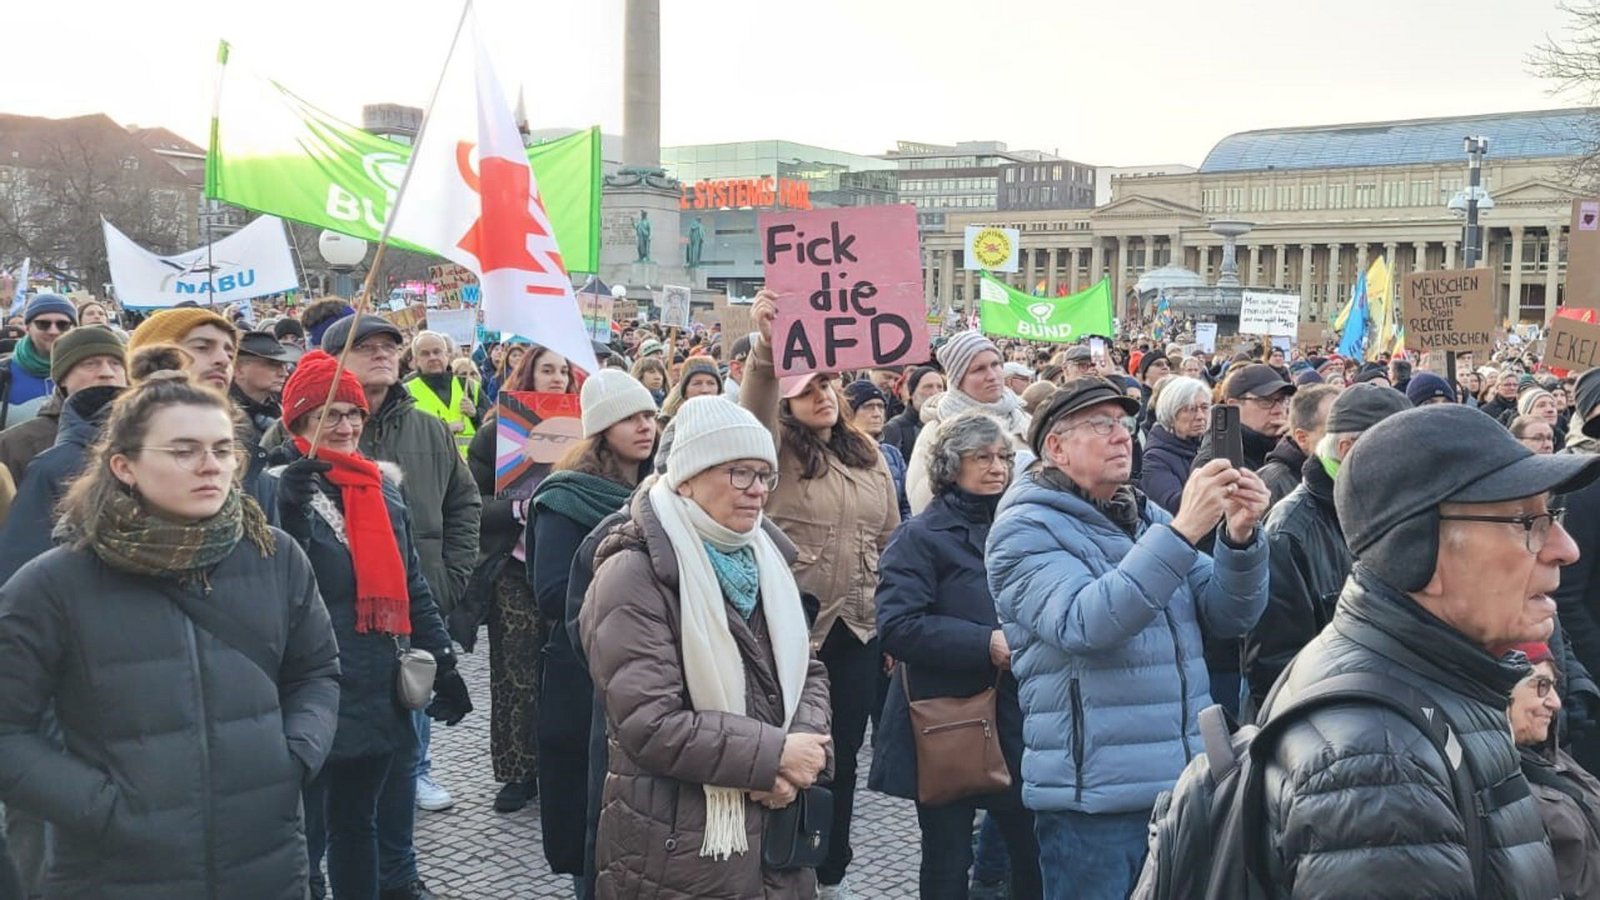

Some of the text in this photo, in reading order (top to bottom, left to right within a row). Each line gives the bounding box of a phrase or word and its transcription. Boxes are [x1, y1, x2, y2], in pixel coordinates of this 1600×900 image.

[694, 177, 775, 209] SYSTEMS
[766, 221, 858, 266] Fick
[175, 269, 255, 294] NABU
[1411, 276, 1478, 298] MENSCHEN
[810, 272, 878, 316] die
[1419, 295, 1462, 312] RECHTE
[1017, 320, 1072, 338] BUND
[1409, 318, 1454, 333] RECHTE
[782, 313, 913, 370] AFD
[1420, 332, 1489, 348] MENSCHEN
